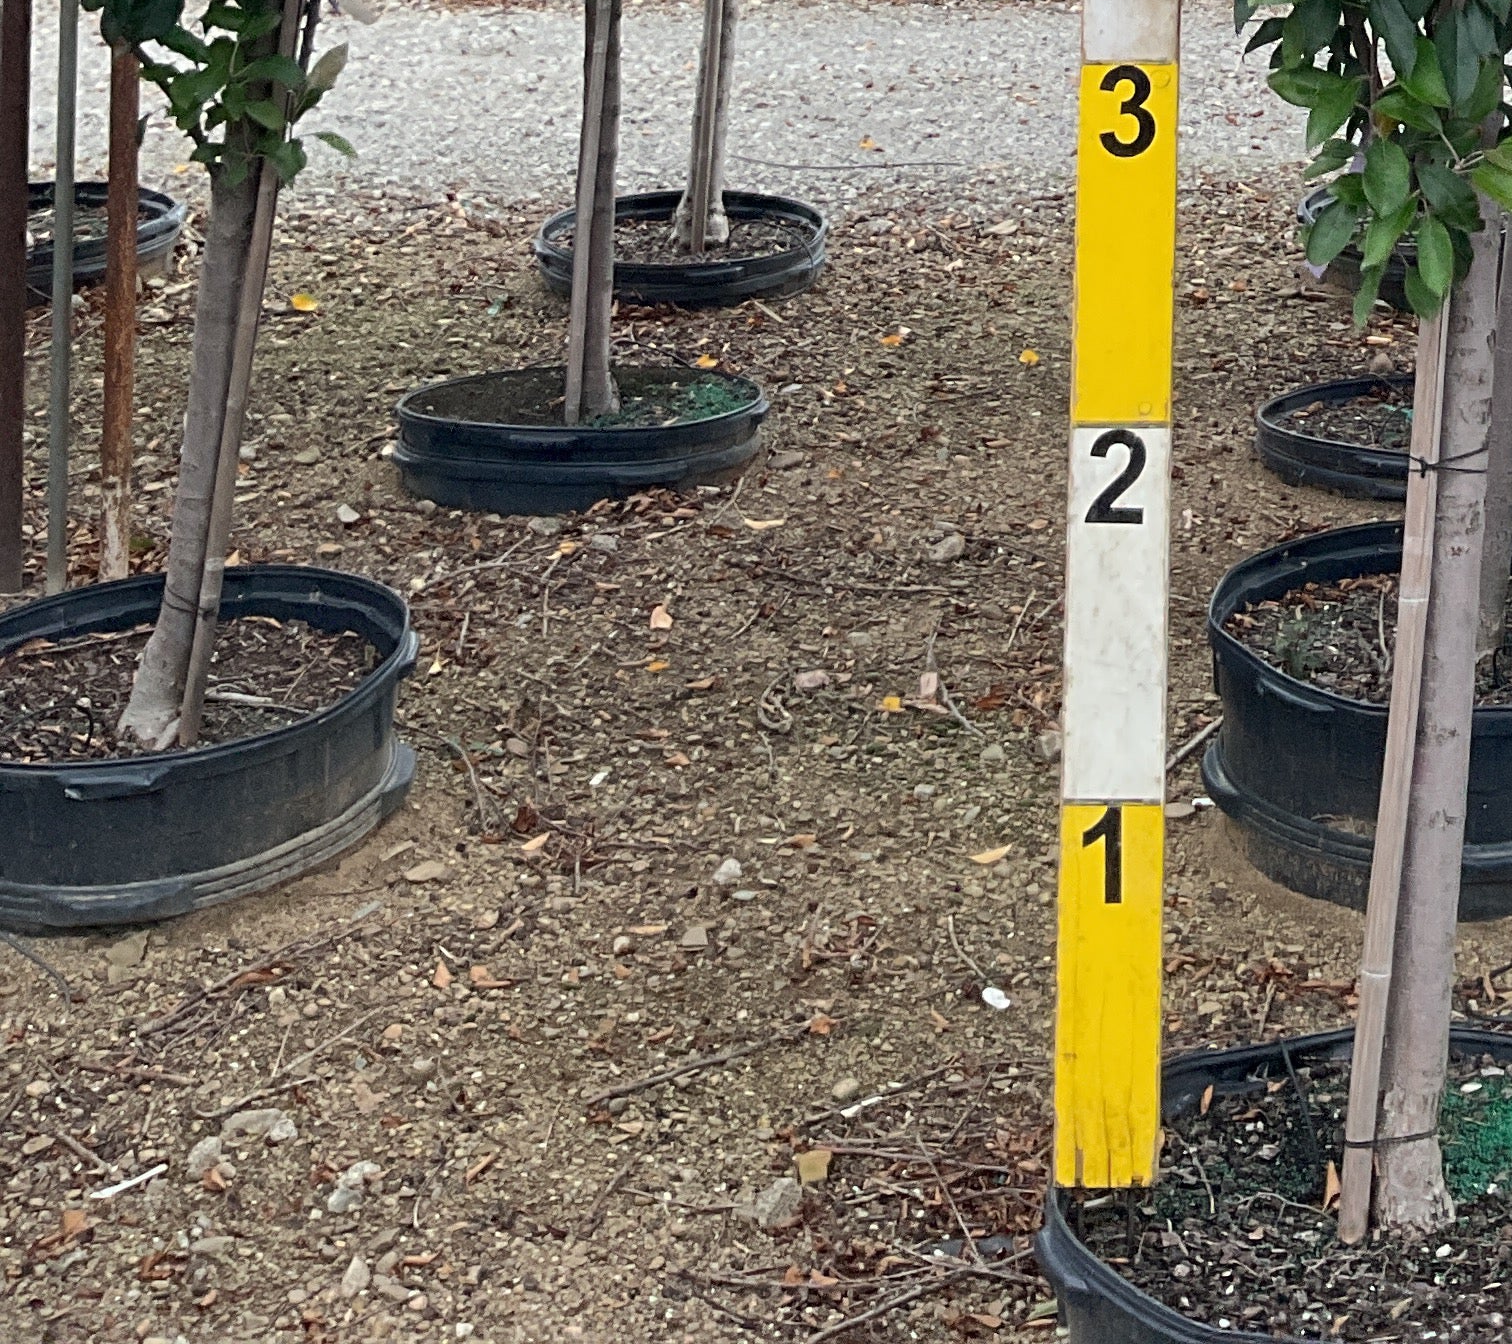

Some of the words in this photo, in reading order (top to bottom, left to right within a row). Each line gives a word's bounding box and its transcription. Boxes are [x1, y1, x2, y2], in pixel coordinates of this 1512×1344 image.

[1099, 64, 1156, 157] 3
[1085, 429, 1147, 524] 2
[1082, 802, 1122, 904] 1
